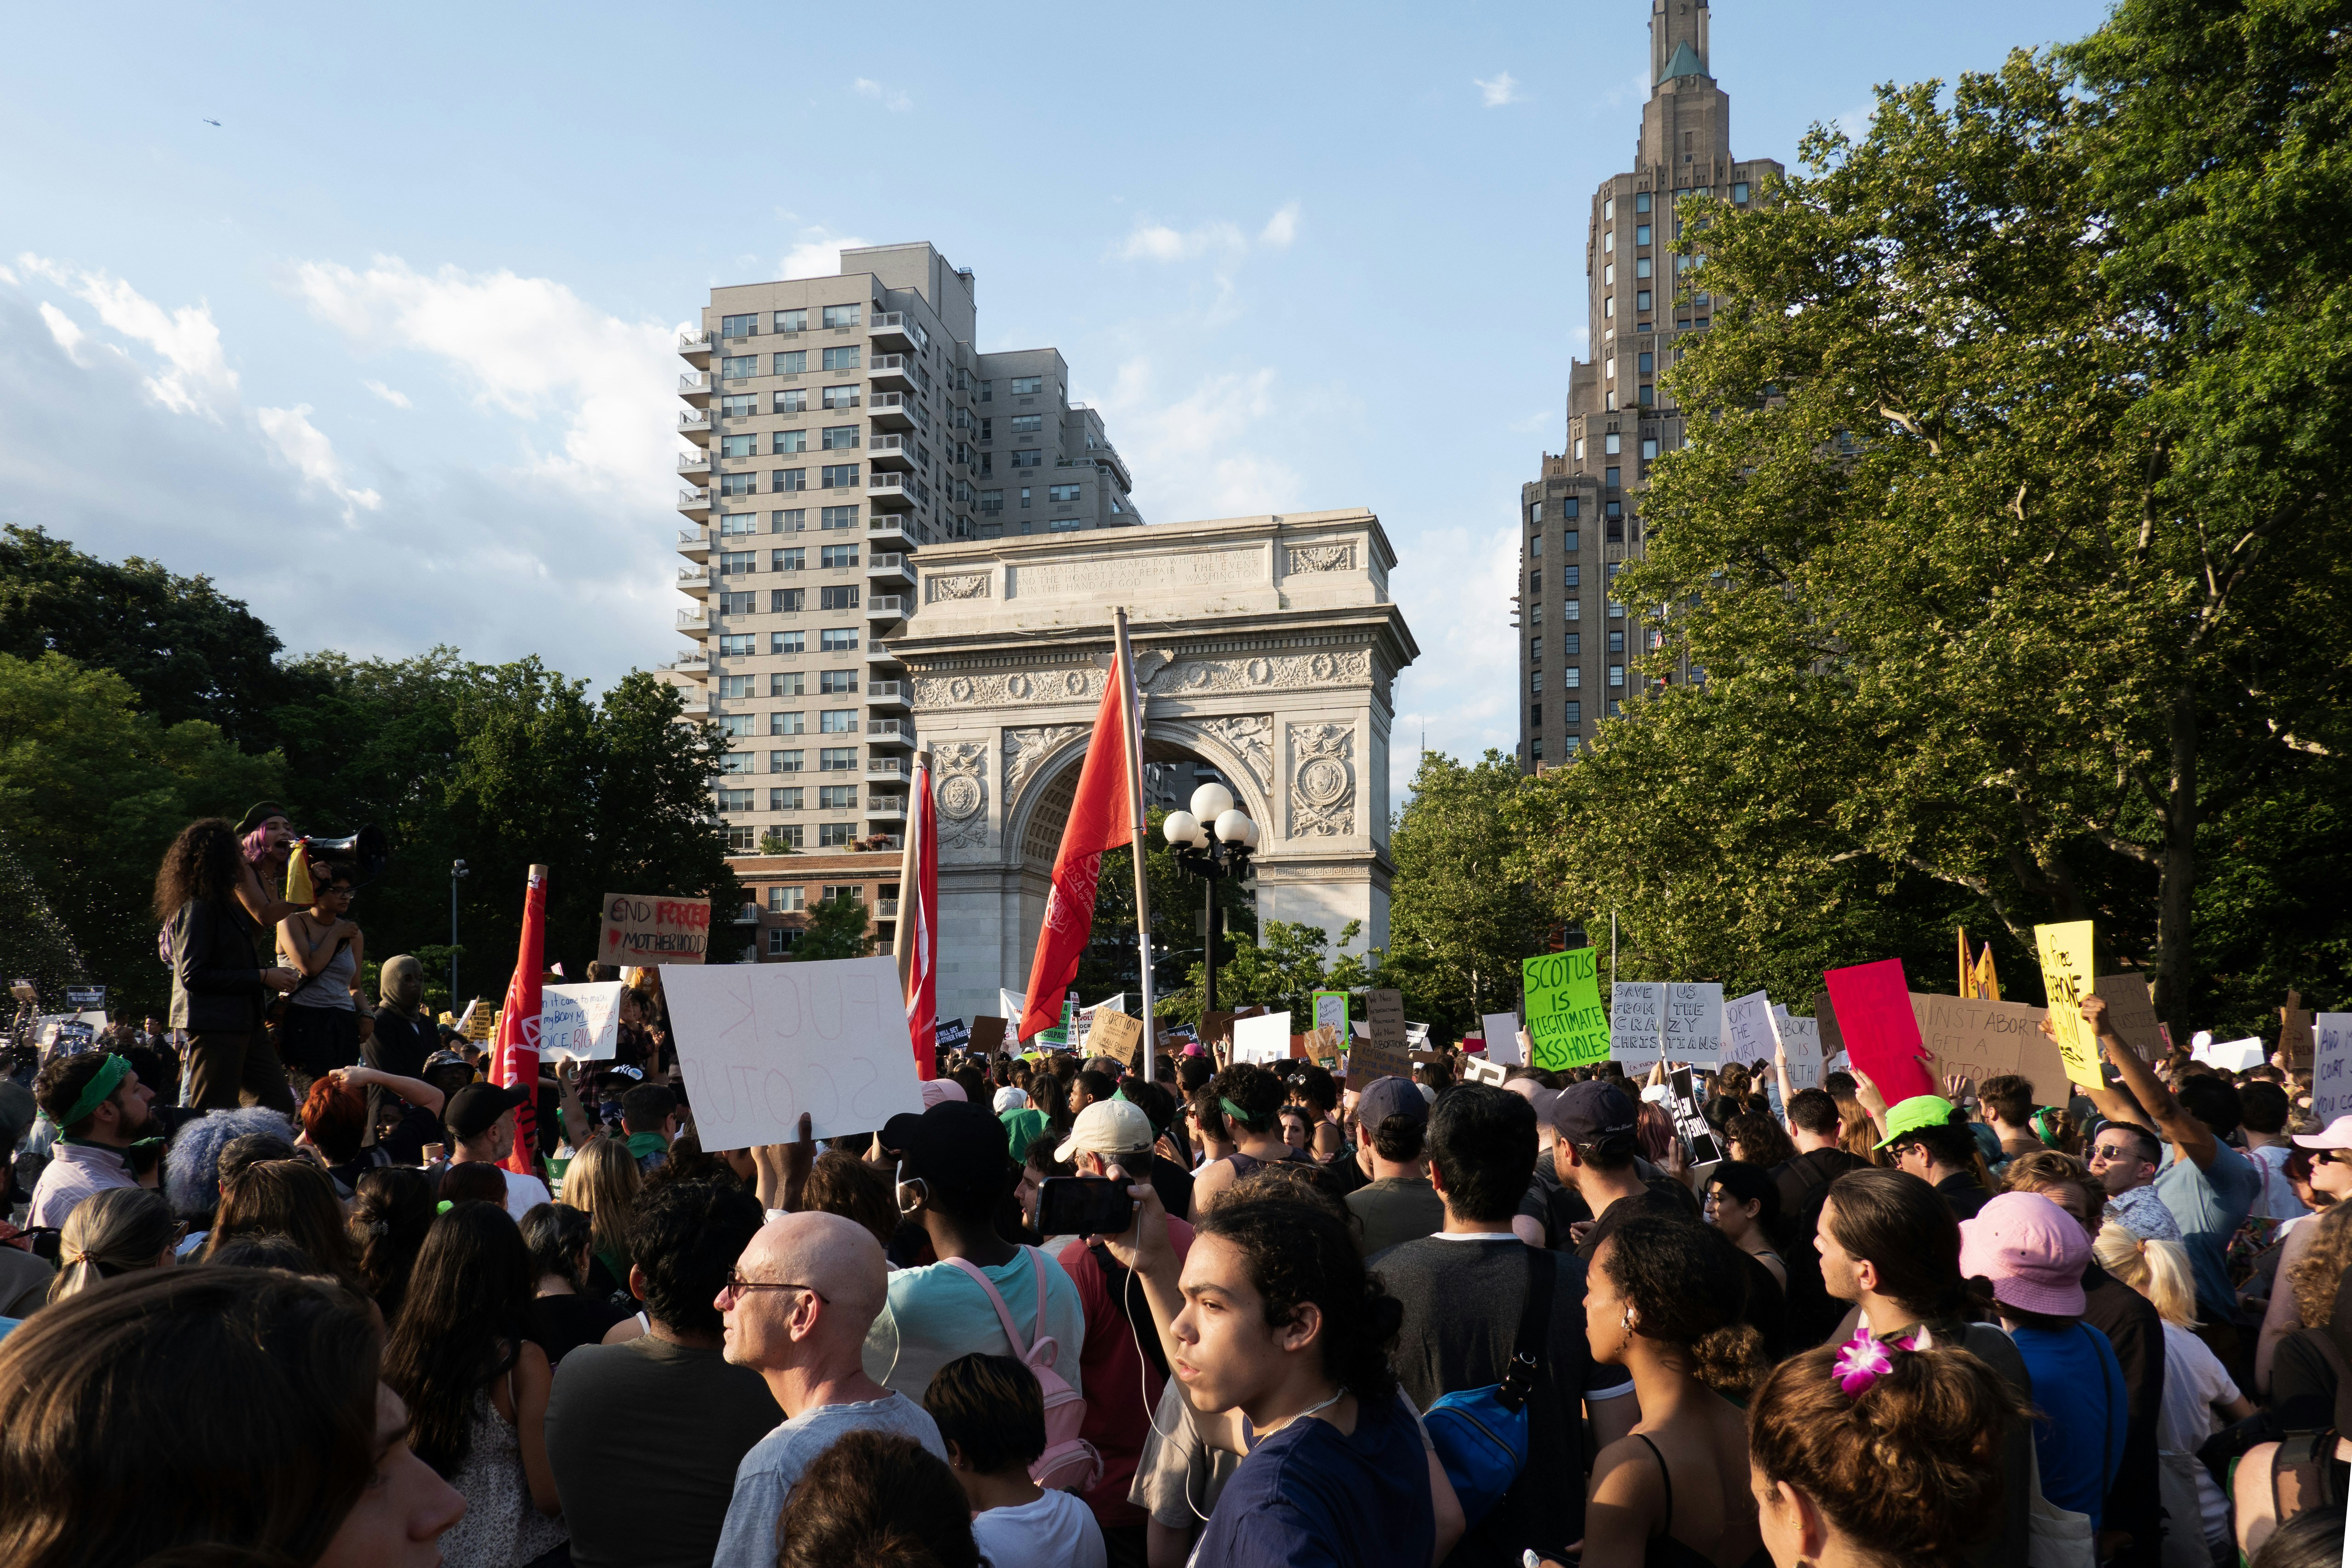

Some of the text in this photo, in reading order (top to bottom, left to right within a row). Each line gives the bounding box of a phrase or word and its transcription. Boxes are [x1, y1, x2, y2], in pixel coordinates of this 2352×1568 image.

[1037, 567, 1048, 575] US
[1051, 564, 1079, 574] RAISE
[1093, 559, 1148, 571] STANDARD
[1151, 558, 1166, 567] TO
[1169, 555, 1204, 565] WHICH
[1208, 553, 1229, 562] THE
[1232, 550, 1258, 560] WISE
[1016, 560, 1258, 586] AND THE HONEST CAN REPAIR THE EVENT
[1028, 586, 1037, 594] IN
[1041, 584, 1061, 593] THE
[1066, 582, 1096, 591] HAND
[1100, 580, 1114, 589] OF
[1118, 578, 1141, 587] GOD
[1185, 569, 1259, 582] WASHINGTON
[1065, 864, 1086, 891] DSA
[1078, 892, 1086, 901] OF
[611, 897, 651, 923] END
[622, 932, 707, 954] MOTHERHOOD
[2051, 934, 2073, 967] free
[1526, 951, 1594, 995] SCOTUS
[561, 997, 578, 1007] came
[581, 994, 589, 1004] to
[1552, 990, 1571, 1013] IS
[1614, 984, 1698, 999] SAVE US
[1820, 995, 1830, 1006] MY
[576, 1008, 589, 1022] MY
[1614, 1002, 1704, 1016] FROM THE
[1097, 1008, 1138, 1032] ABORTION
[1527, 1006, 1603, 1039] ILLEGITIMATE
[1825, 1019, 1834, 1028] MY
[573, 1024, 613, 1051] RIGHT?
[939, 1029, 950, 1037] WILL
[942, 1030, 967, 1043] OTHER FREE
[1091, 1031, 1097, 1042] A
[1096, 1036, 1114, 1047] HUMAN
[1114, 1041, 1131, 1052] RIGHT
[1611, 1035, 1719, 1050] CHRISTIANS
[1730, 1023, 1751, 1042] THE
[2319, 1028, 2339, 1055] ADD
[1352, 1044, 1358, 1053] I
[1373, 1039, 1407, 1050] ABORTIONS
[1534, 1031, 1610, 1068] ASSHOLES
[1798, 1042, 1809, 1056] IS
[1932, 1032, 1988, 1054] GET A
[1349, 1066, 1361, 1075] NOT
[2316, 1094, 2335, 1113] YOU
